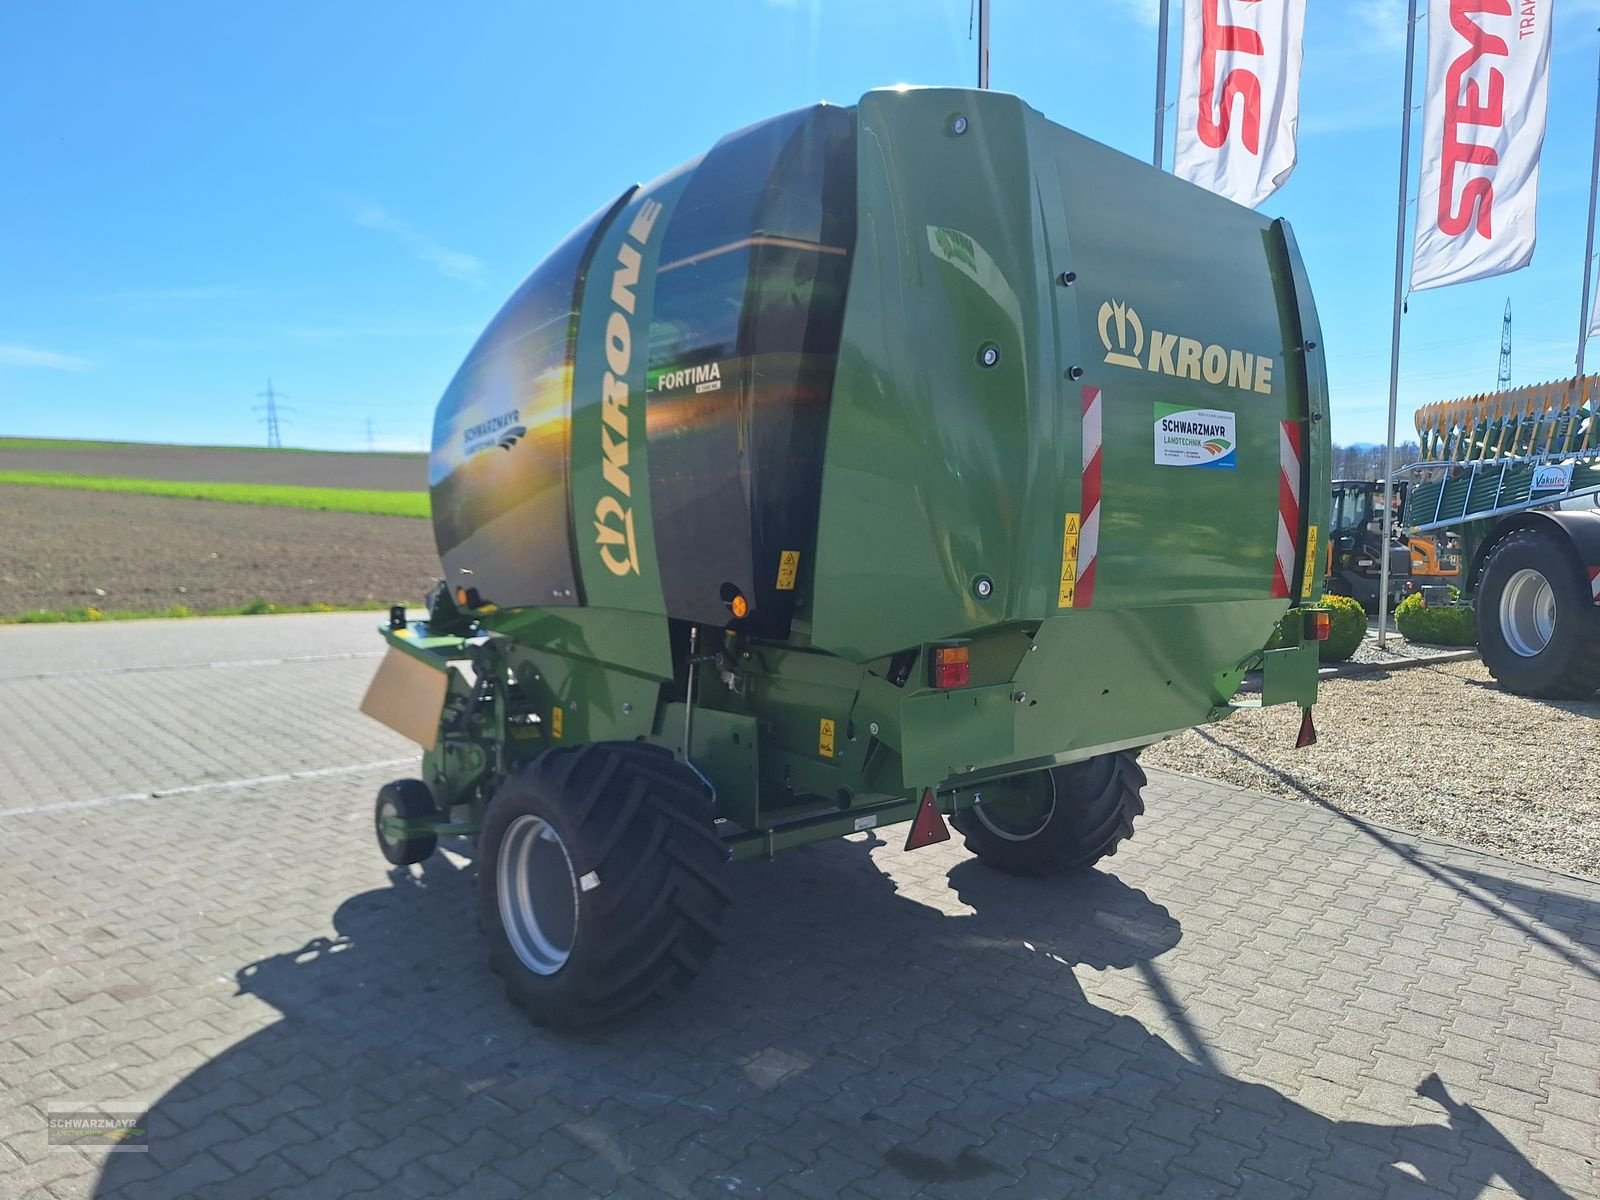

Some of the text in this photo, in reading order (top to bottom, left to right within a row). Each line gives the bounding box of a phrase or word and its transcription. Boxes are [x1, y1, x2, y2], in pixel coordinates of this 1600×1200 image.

[1197, 0, 1265, 156] ST
[602, 197, 662, 497] KRONE
[1148, 330, 1273, 394] KRONE
[658, 362, 721, 392] FORTIMA
[1162, 419, 1226, 437] SCHWARZMAYR
[1163, 435, 1202, 447] LANDTECHNIK
[1535, 473, 1567, 487] Vakutec
